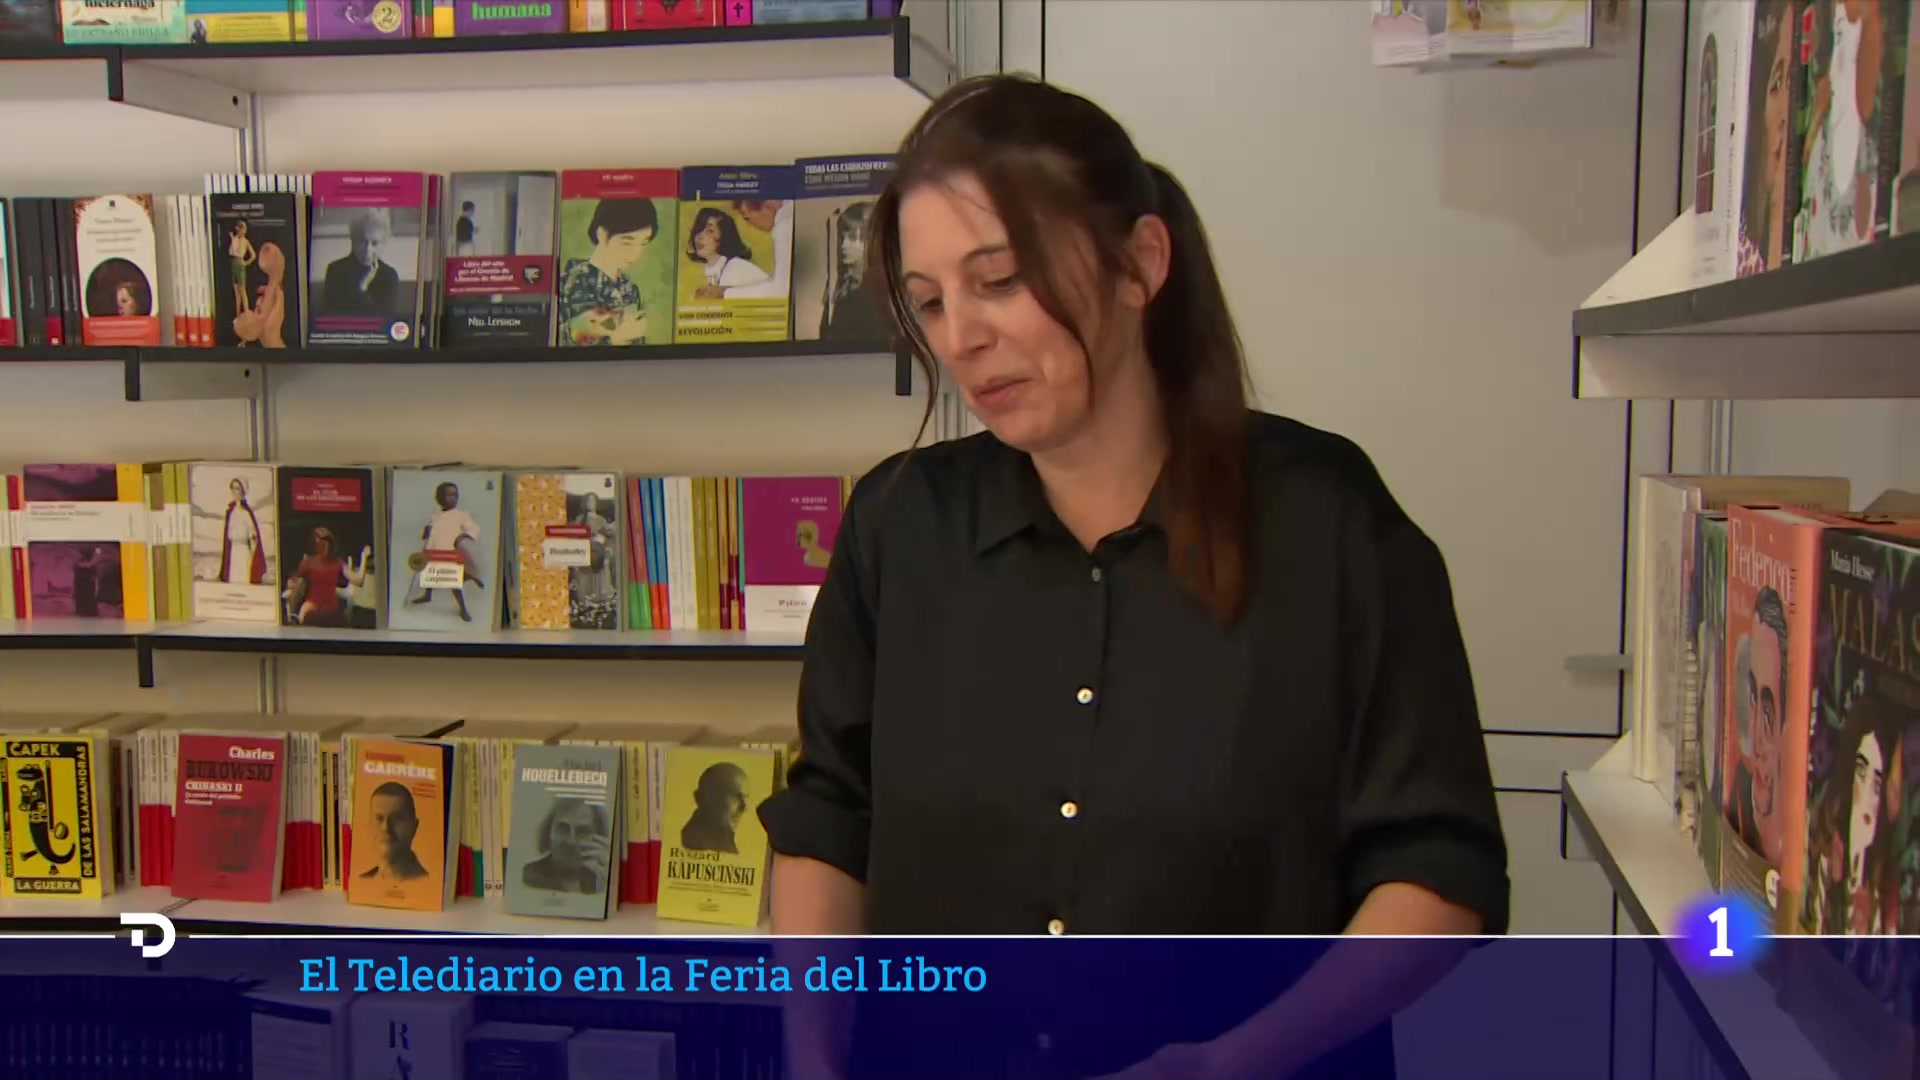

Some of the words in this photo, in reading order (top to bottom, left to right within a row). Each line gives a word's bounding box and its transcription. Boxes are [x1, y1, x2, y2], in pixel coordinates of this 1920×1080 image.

[472, 2, 552, 20] humana
[827, 163, 839, 172] LAS
[1729, 518, 1790, 605] Federico
[1851, 555, 1875, 582] Hesse
[229, 745, 275, 760] Charles
[186, 761, 273, 782] BUKOWSKI
[521, 767, 608, 788] HOUELLEBECQ
[76, 745, 92, 834] SALAMANDRAS
[81, 837, 93, 860] LAS
[670, 847, 721, 862] Ryszard
[82, 862, 94, 876] DE
[667, 861, 756, 886] KAPUŚCIŃSKI
[16, 880, 31, 891] LA
[33, 881, 80, 892] GUERRA
